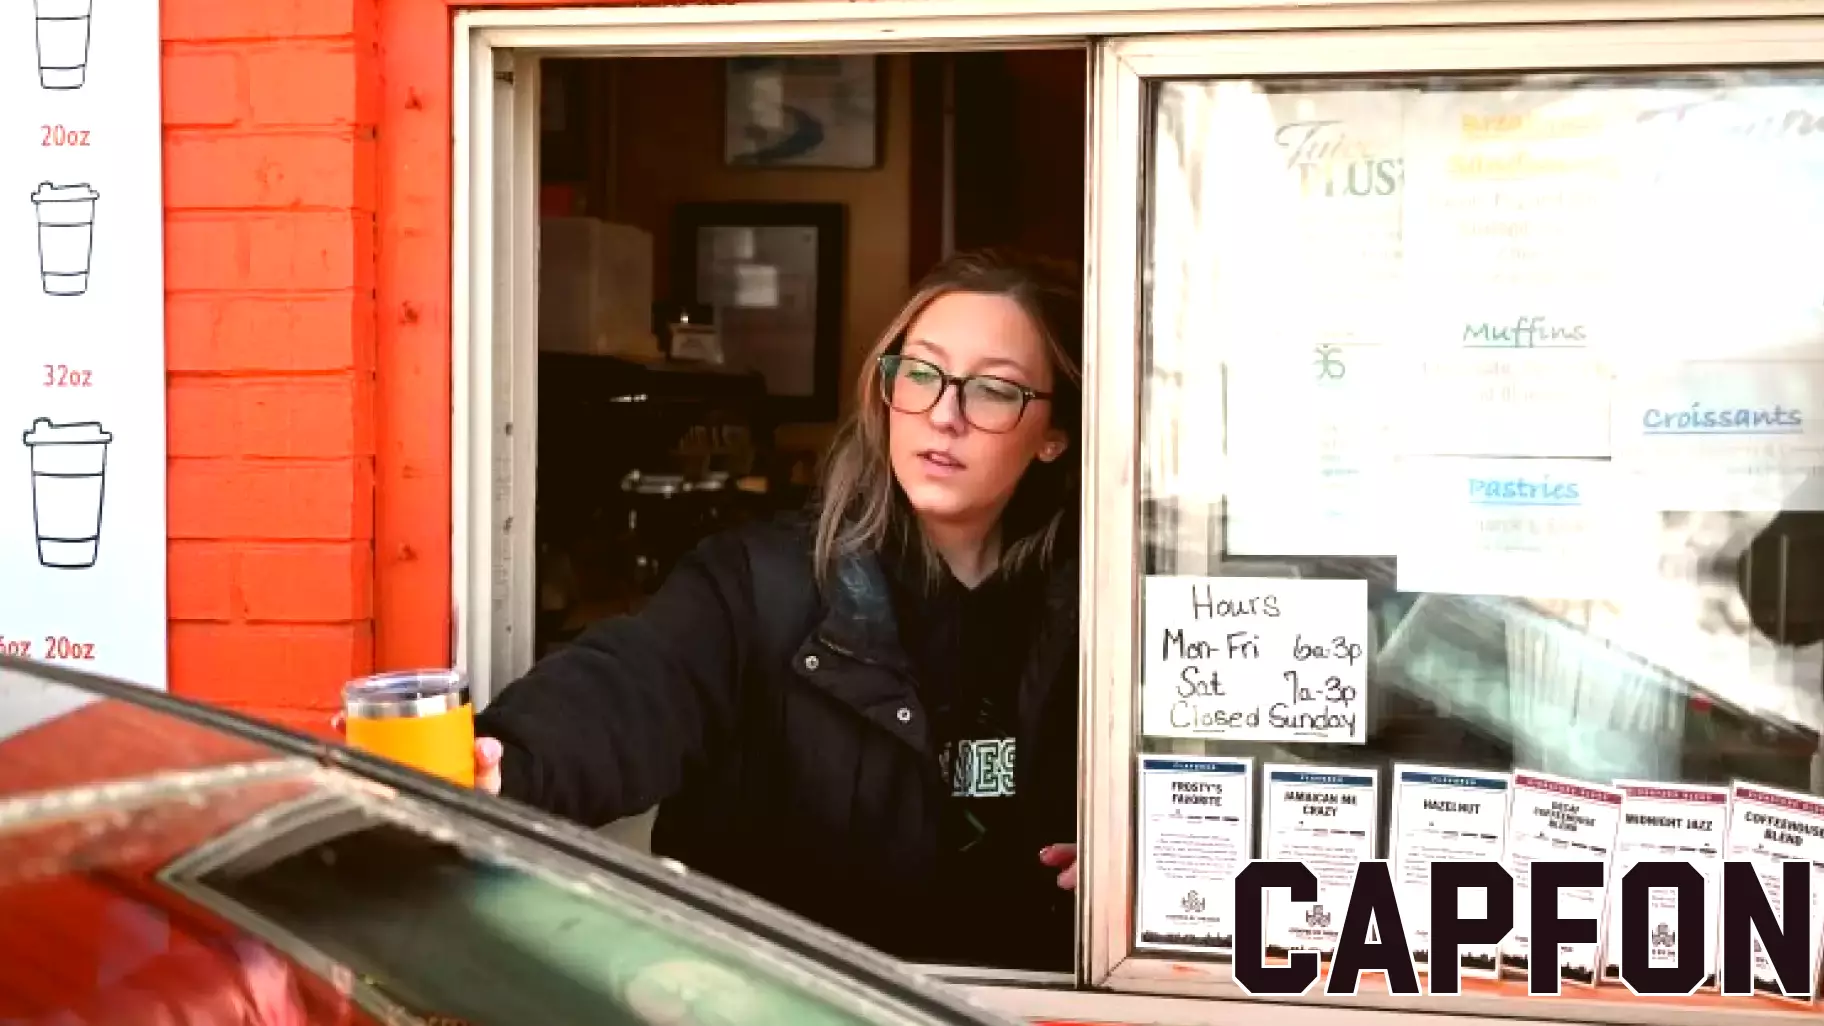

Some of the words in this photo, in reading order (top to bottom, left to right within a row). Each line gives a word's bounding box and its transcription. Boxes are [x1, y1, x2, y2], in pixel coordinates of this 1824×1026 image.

[41, 124, 91, 146] 20oz
[1463, 316, 1587, 348] Muffins
[43, 364, 93, 387] 32oz
[1643, 401, 1802, 430] Croissants
[1469, 474, 1580, 500] Pastries
[1192, 583, 1281, 619] Hours
[45, 635, 96, 659] 20oz
[1176, 665, 1226, 698] Sat
[1169, 700, 1260, 729] Closed
[1268, 702, 1356, 738] Sunday
[1302, 804, 1339, 818] CRAZY
[1423, 798, 1482, 815] HAZELNUT
[1625, 813, 1684, 829] MIDNIGHT
